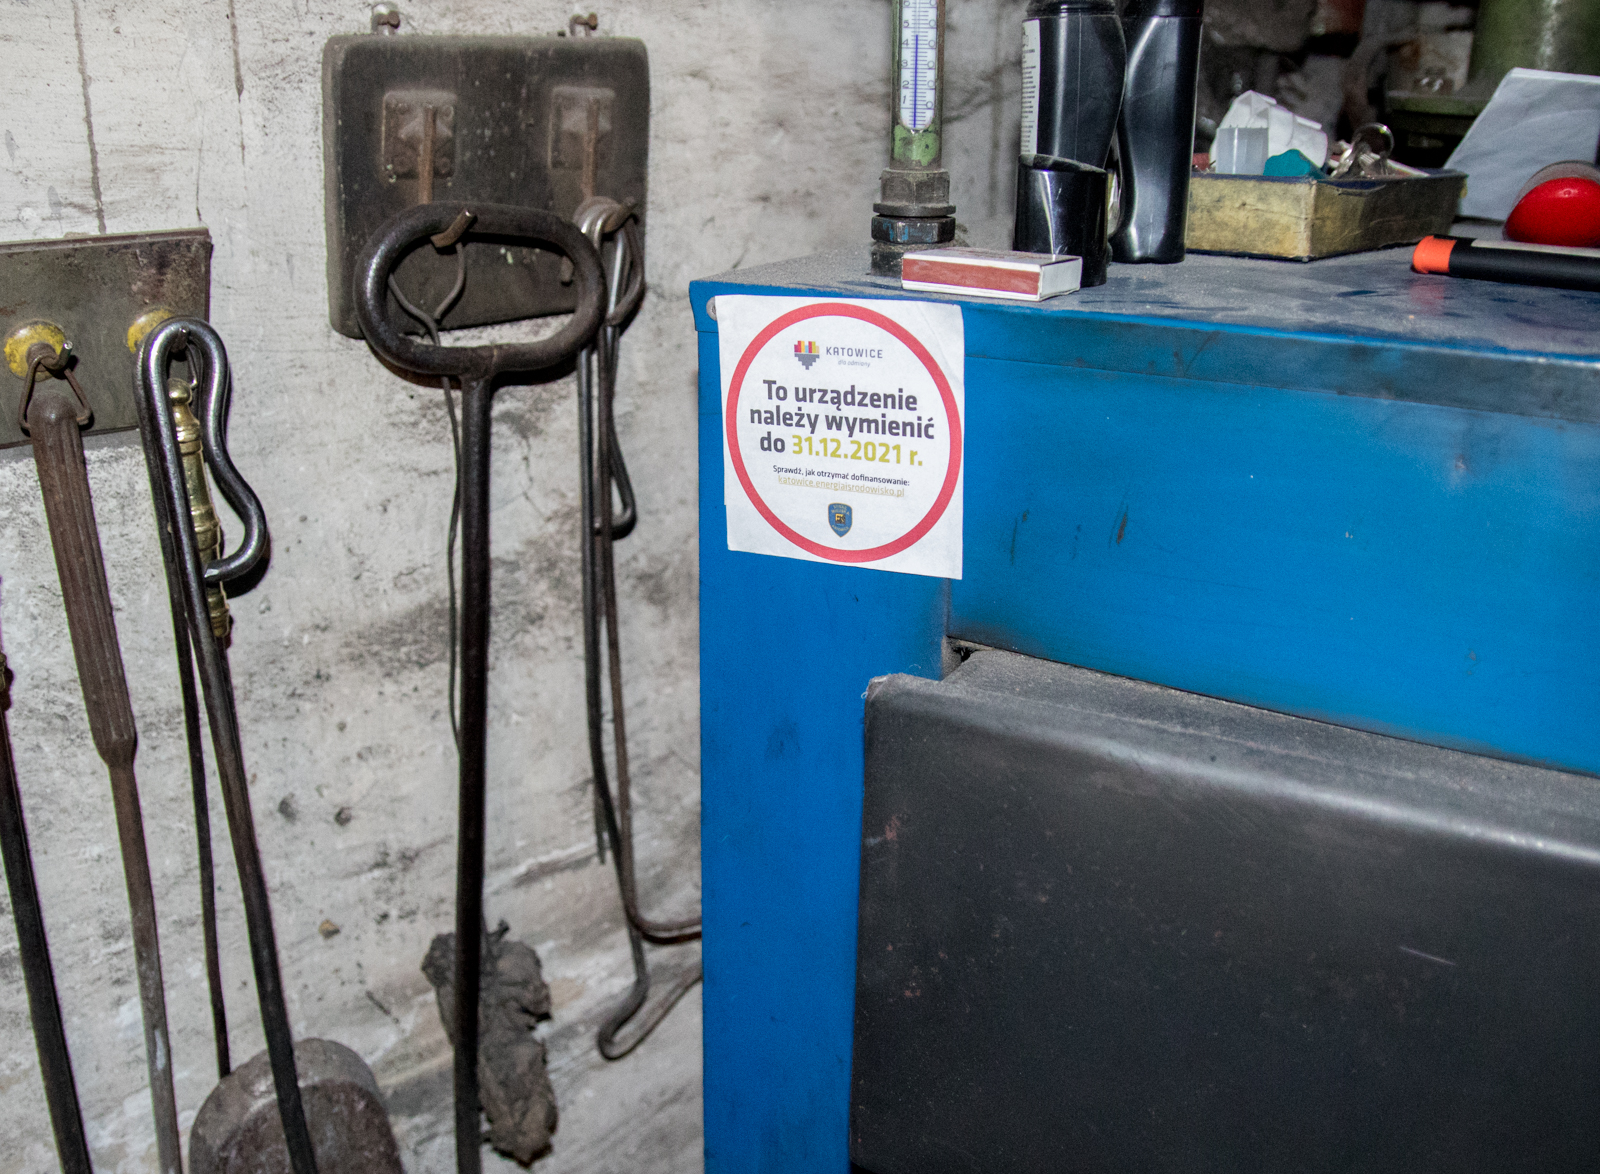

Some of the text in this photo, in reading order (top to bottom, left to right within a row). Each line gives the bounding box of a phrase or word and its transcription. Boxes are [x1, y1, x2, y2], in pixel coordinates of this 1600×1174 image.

[825, 346, 883, 359] KATOWICE
[762, 379, 918, 411] To urządzenie
[749, 405, 935, 440] należy wymienić
[760, 431, 923, 466] do 31.12.2021 r.
[777, 475, 905, 498] katowice.energiaisrodowisko.pl
[805, 467, 816, 477] jak
[816, 470, 850, 481] otrzymać
[850, 473, 910, 486] dofinansowanie:
